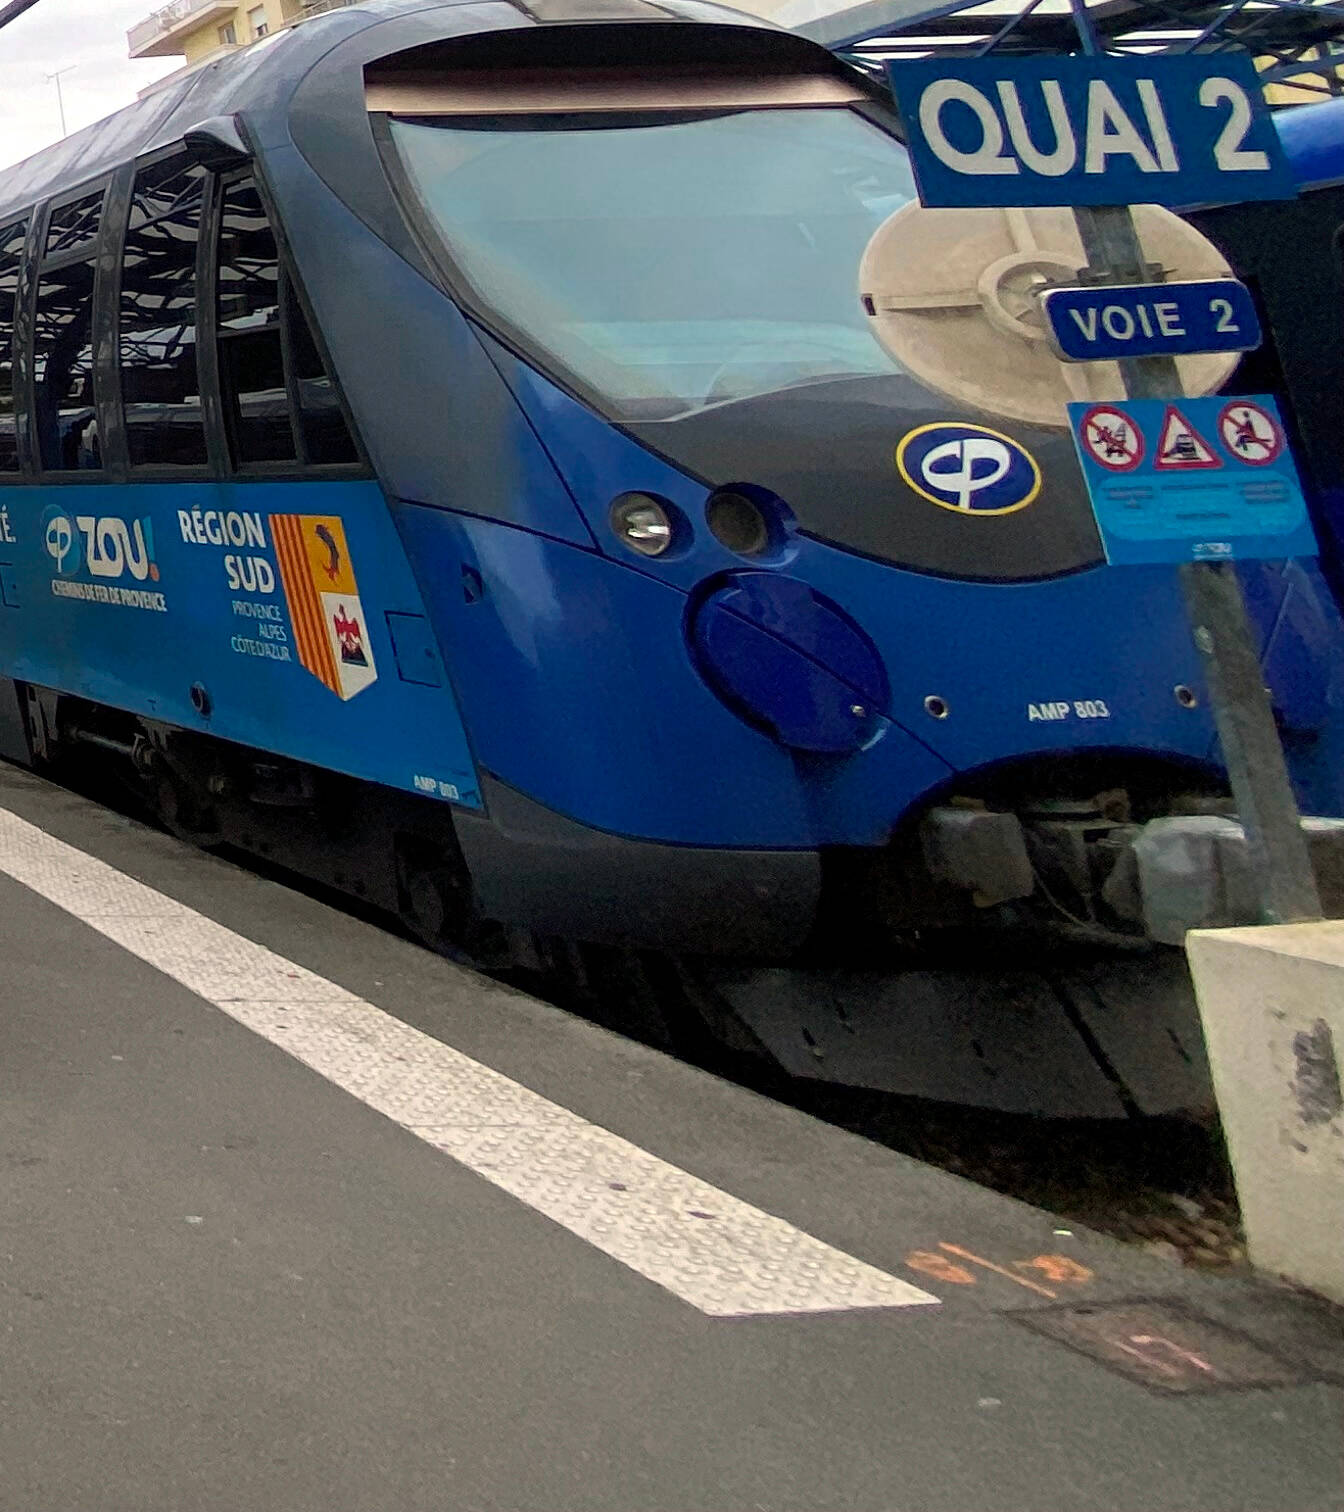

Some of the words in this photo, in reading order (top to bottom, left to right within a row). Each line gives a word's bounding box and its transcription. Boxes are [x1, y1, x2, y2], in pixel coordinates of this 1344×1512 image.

[918, 78, 1180, 177] QUAI
[1198, 76, 1272, 173] 2
[1067, 301, 1187, 344] VOIE
[1208, 299, 1242, 334] 2
[177, 504, 266, 548] RÉGION
[76, 516, 160, 582] ZOU!
[224, 554, 275, 593] SUD
[232, 600, 283, 622] PROVENCE
[259, 623, 288, 642] ALPES
[1028, 702, 1070, 722] AMP
[1073, 699, 1110, 719] 803
